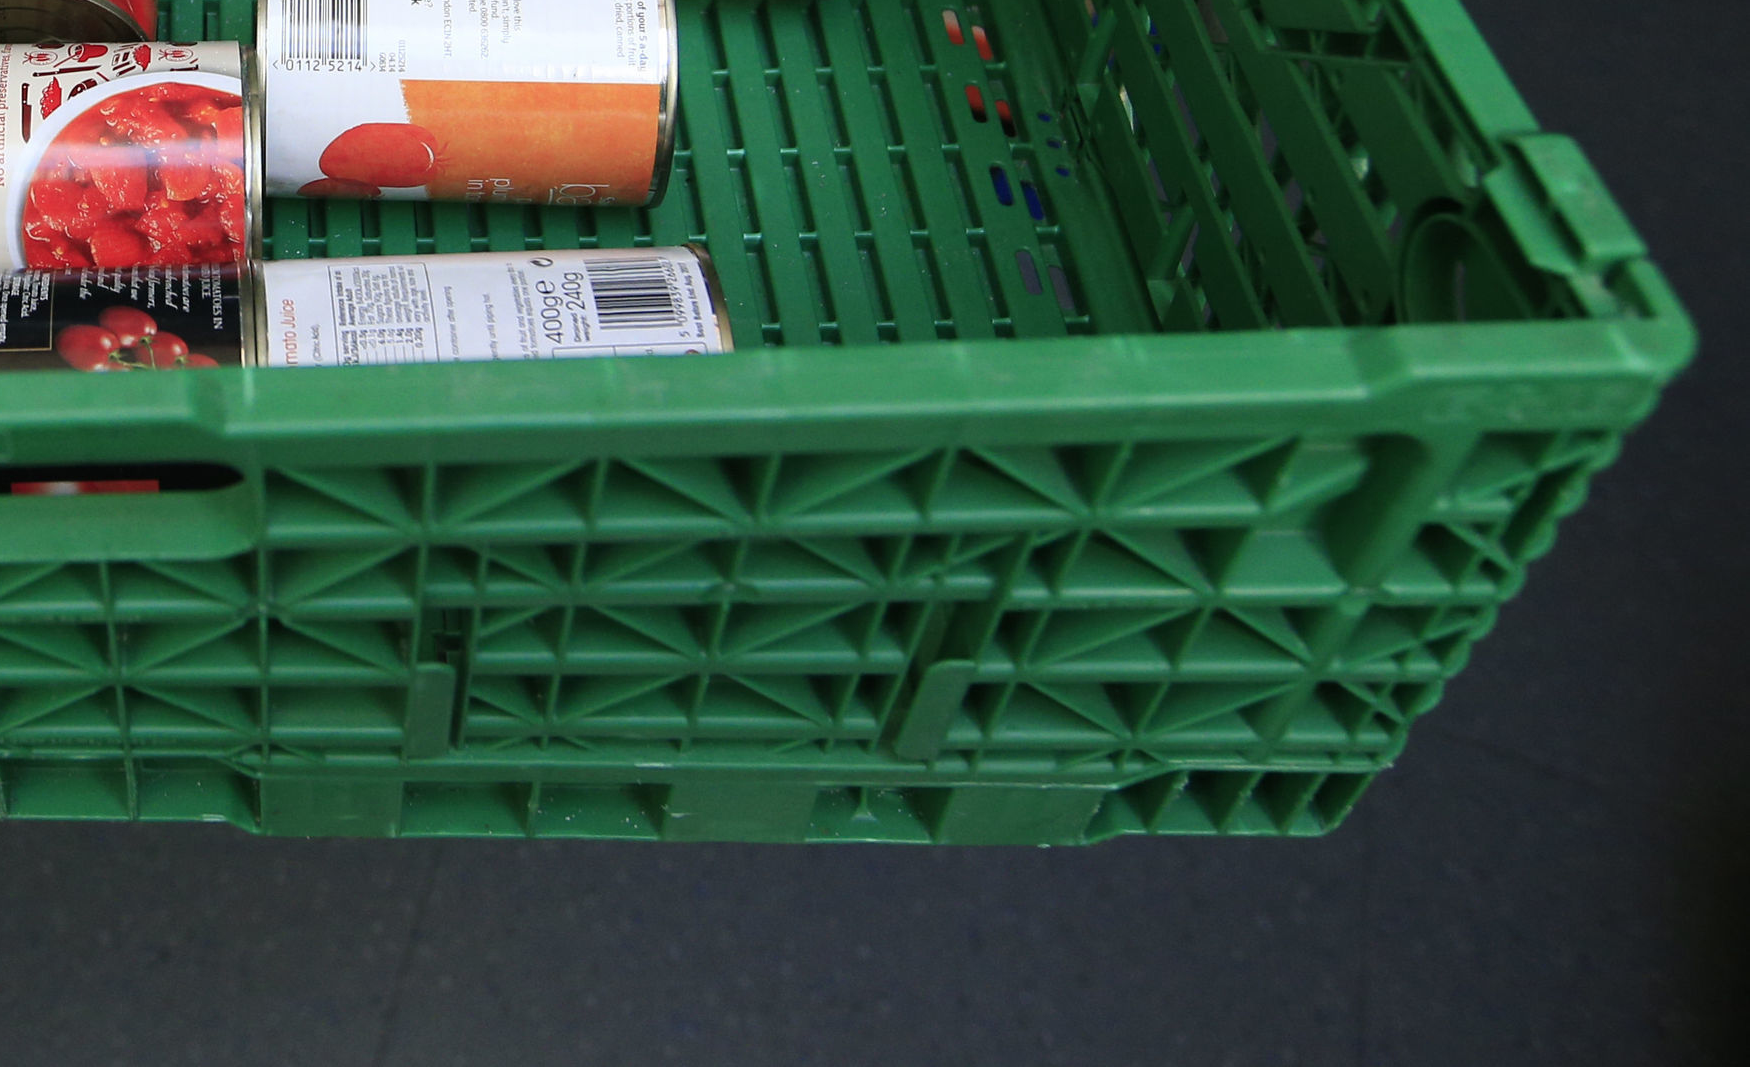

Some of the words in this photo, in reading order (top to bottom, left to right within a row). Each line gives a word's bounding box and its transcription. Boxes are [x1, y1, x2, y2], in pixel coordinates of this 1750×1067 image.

[480, 7, 488, 27] 0800
[637, 1, 646, 10] of
[501, 15, 511, 44] simply
[625, 3, 635, 35] portions
[636, 12, 646, 32] your
[285, 59, 320, 71] 0112
[328, 60, 362, 71] 5214
[561, 272, 585, 311] 240g
[213, 317, 223, 330] IN
[280, 299, 296, 329] Juice
[540, 296, 564, 343] 400g
